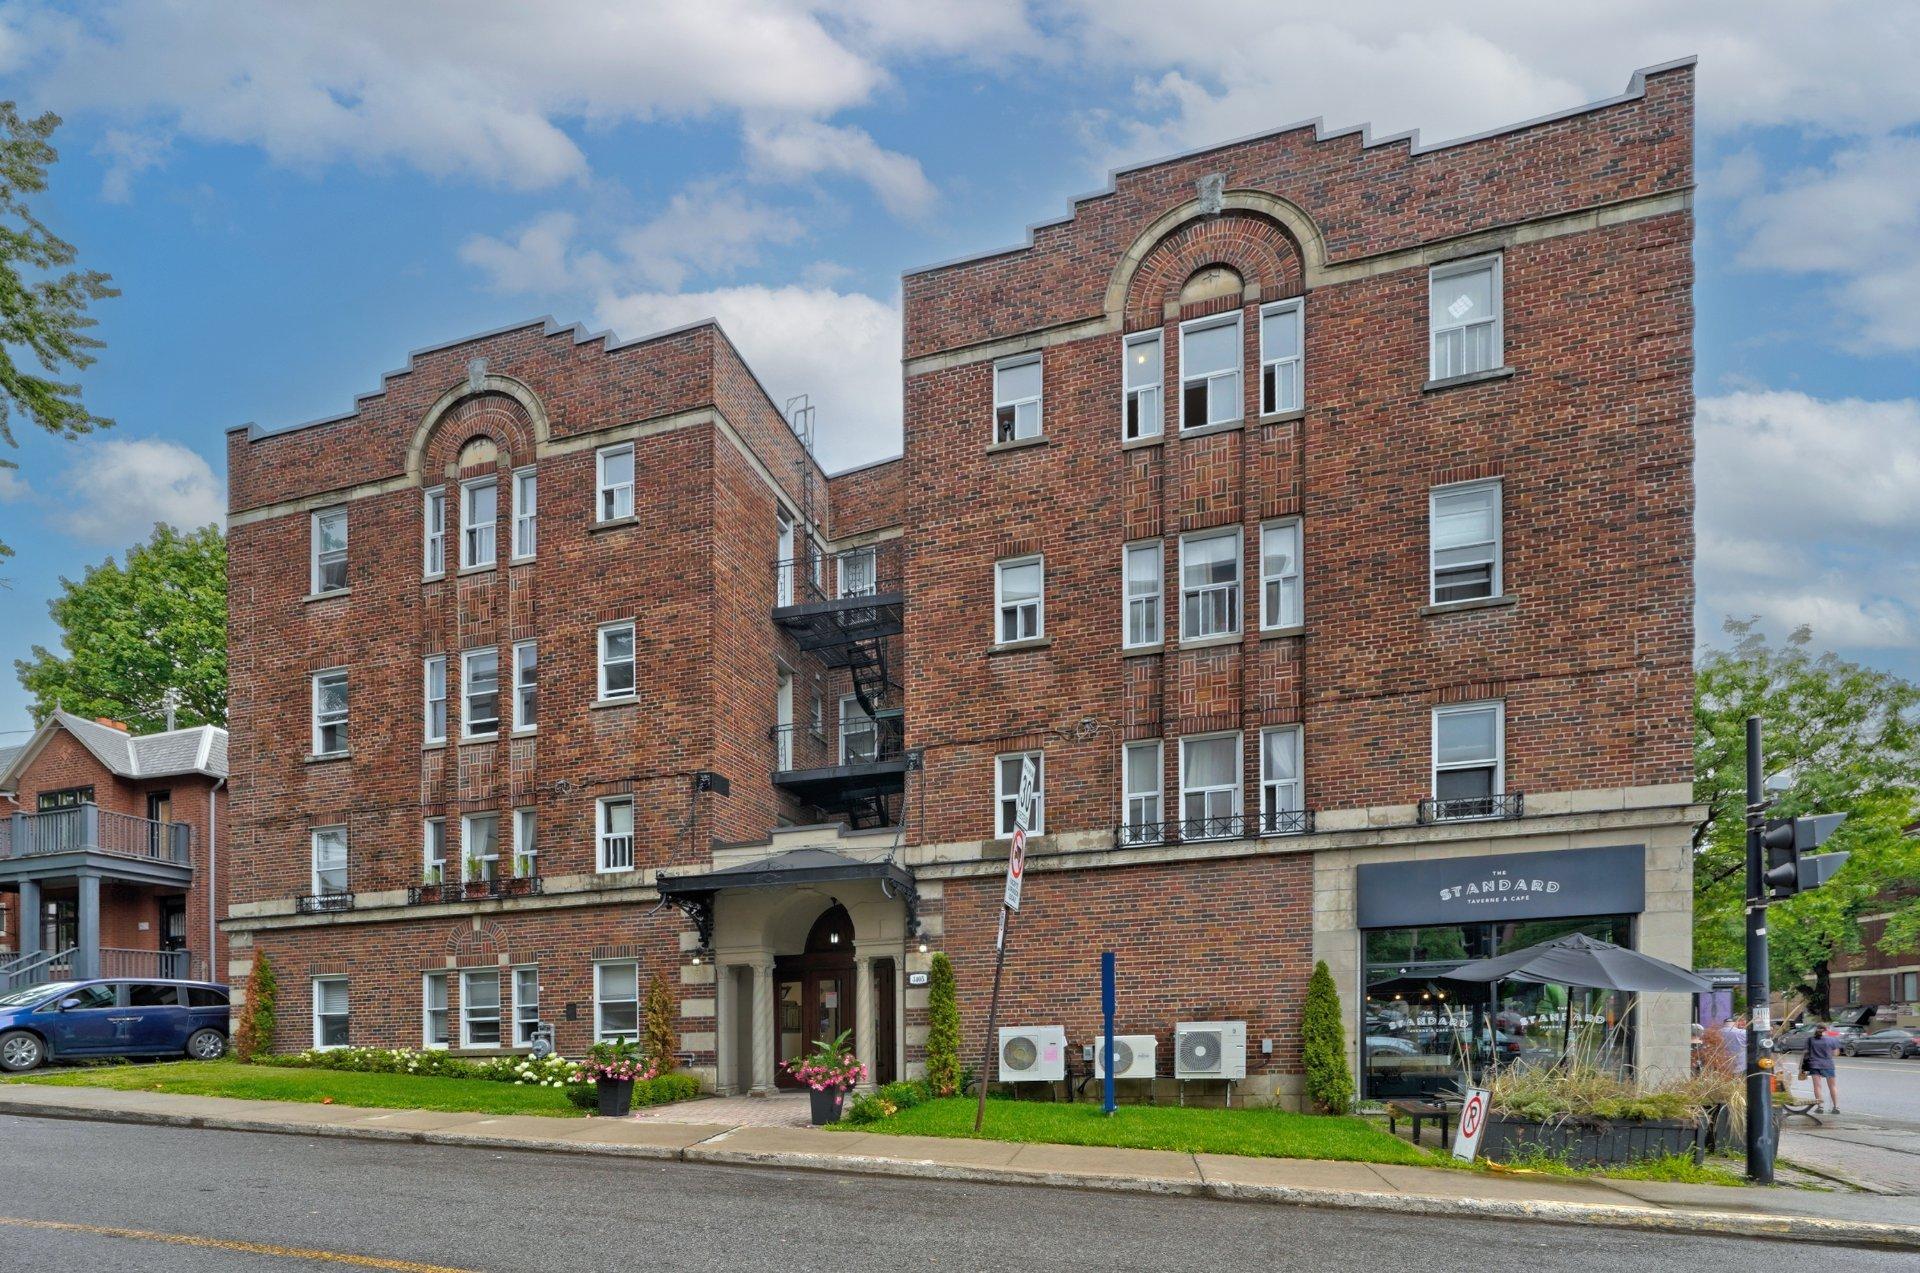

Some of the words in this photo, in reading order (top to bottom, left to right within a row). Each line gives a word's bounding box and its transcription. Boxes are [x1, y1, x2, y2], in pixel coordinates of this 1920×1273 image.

[1020, 774, 1032, 812] 30
[1439, 879, 1560, 901] STANDARD
[1388, 1016, 1469, 1030] STANDARD
